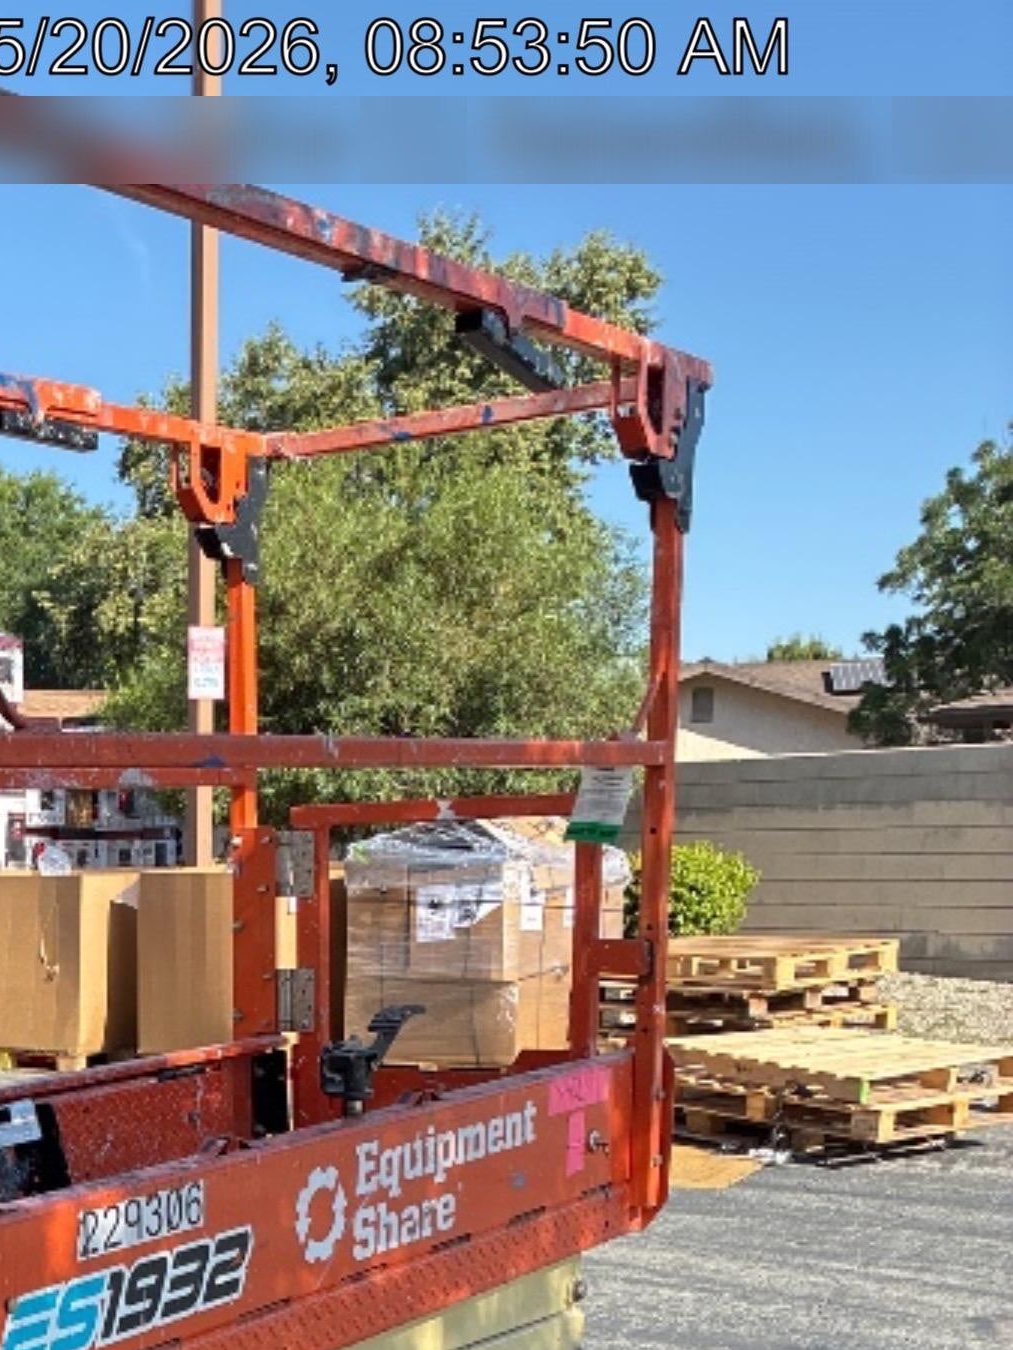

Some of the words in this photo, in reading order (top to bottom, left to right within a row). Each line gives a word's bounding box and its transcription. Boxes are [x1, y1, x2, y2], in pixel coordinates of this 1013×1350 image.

[355, 1100, 537, 1198] Equipment
[79, 1183, 203, 1258] 229306
[352, 1193, 456, 1261] Share
